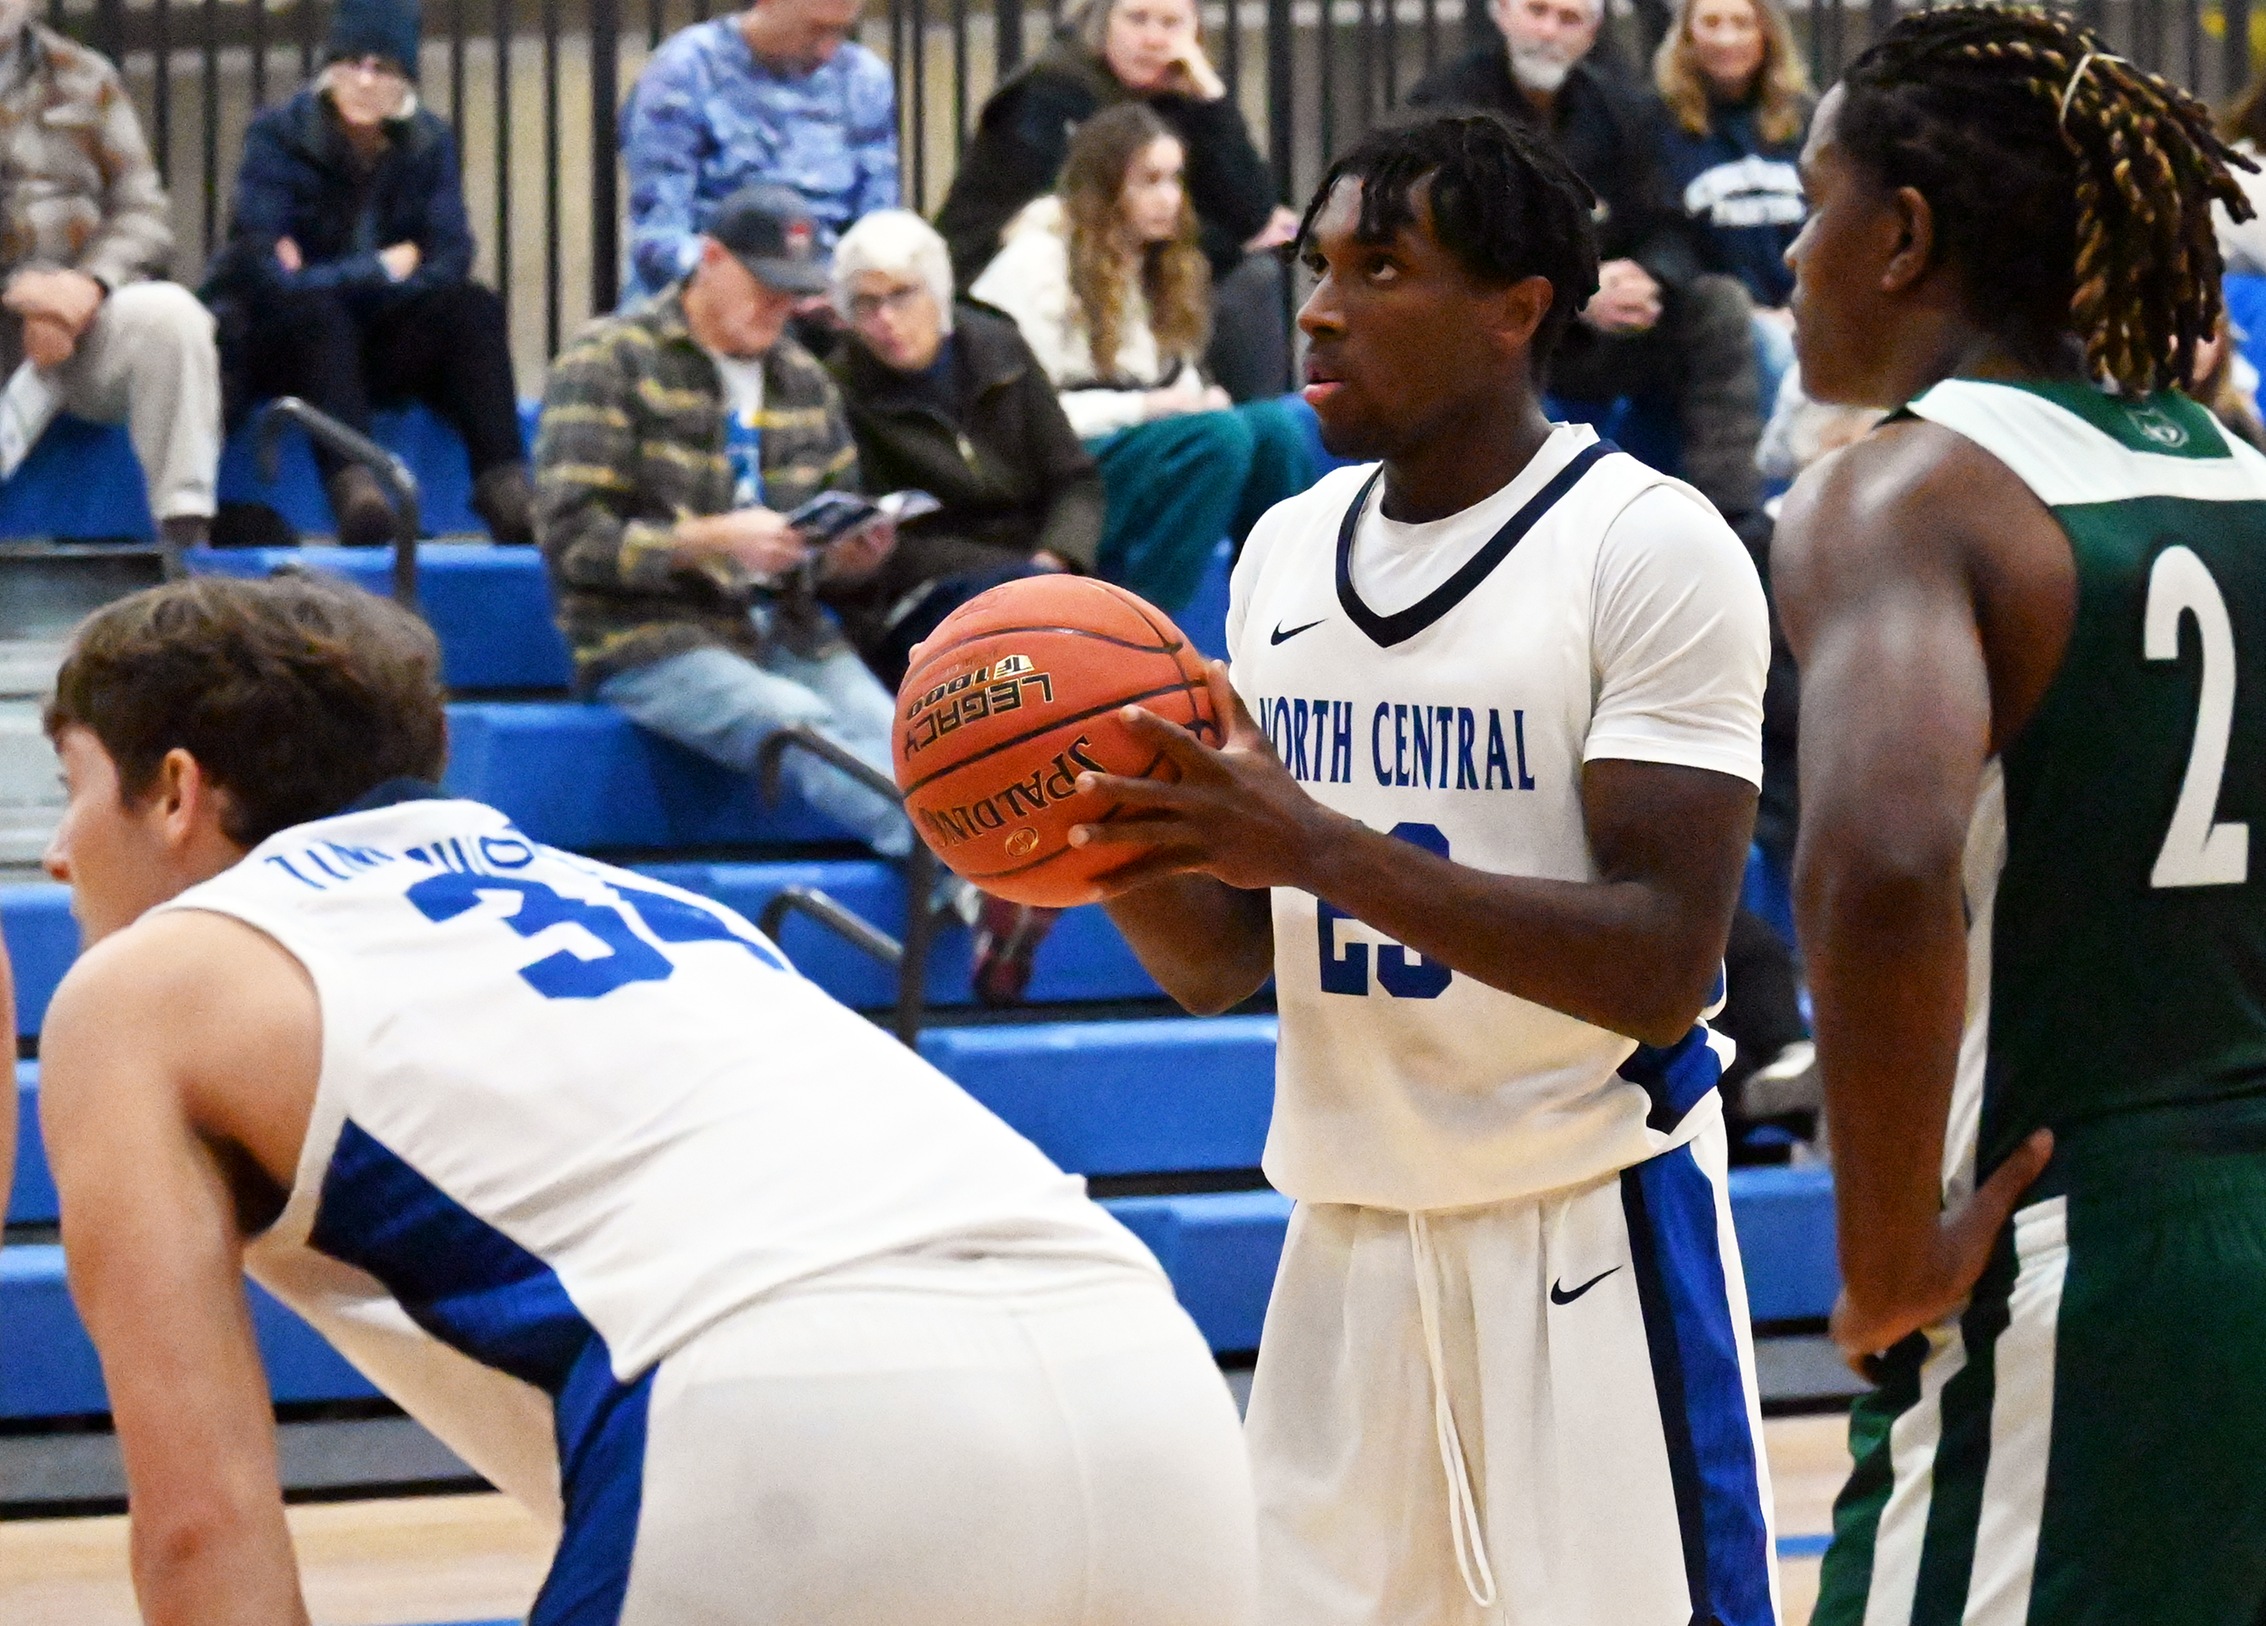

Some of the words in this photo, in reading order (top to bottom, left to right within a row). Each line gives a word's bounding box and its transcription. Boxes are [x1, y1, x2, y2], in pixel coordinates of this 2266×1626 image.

[905, 672, 1054, 762] LEGACY
[1372, 702, 1535, 791] CENTRAL
[2145, 545, 2249, 888] 2
